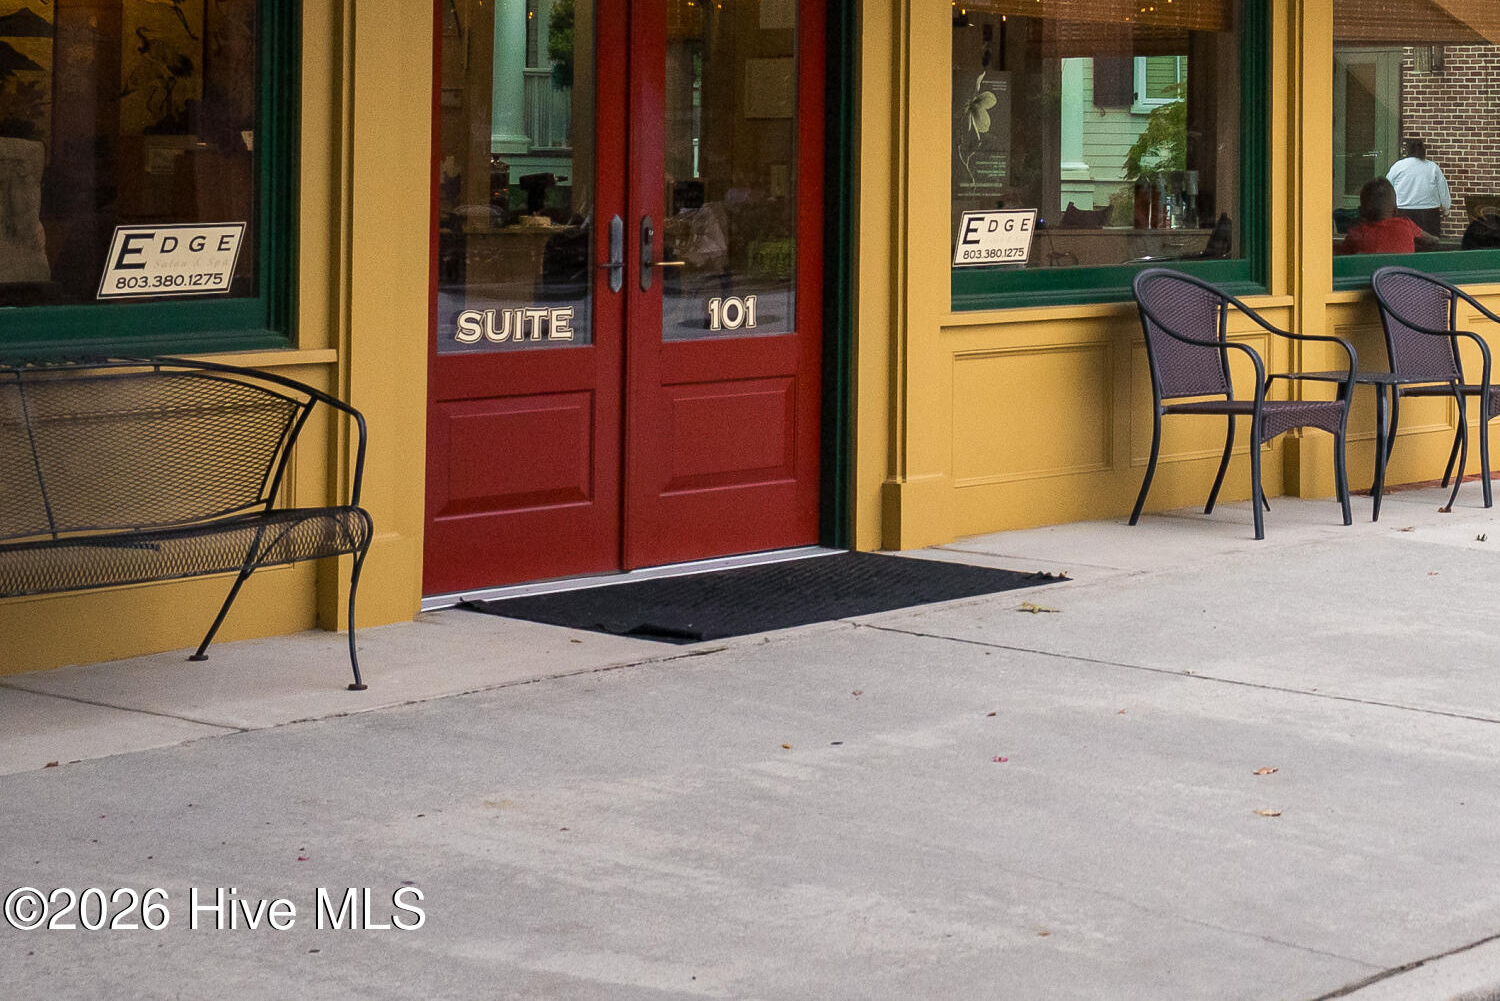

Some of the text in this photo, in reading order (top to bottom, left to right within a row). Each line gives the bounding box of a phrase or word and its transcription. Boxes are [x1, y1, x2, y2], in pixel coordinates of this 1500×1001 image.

[961, 216, 1031, 245] EDGE
[112, 231, 235, 271] EDGE
[963, 247, 1025, 260] 803.380.1275
[115, 272, 224, 290] 803.380.1275
[454, 295, 758, 344] SUITE 101
